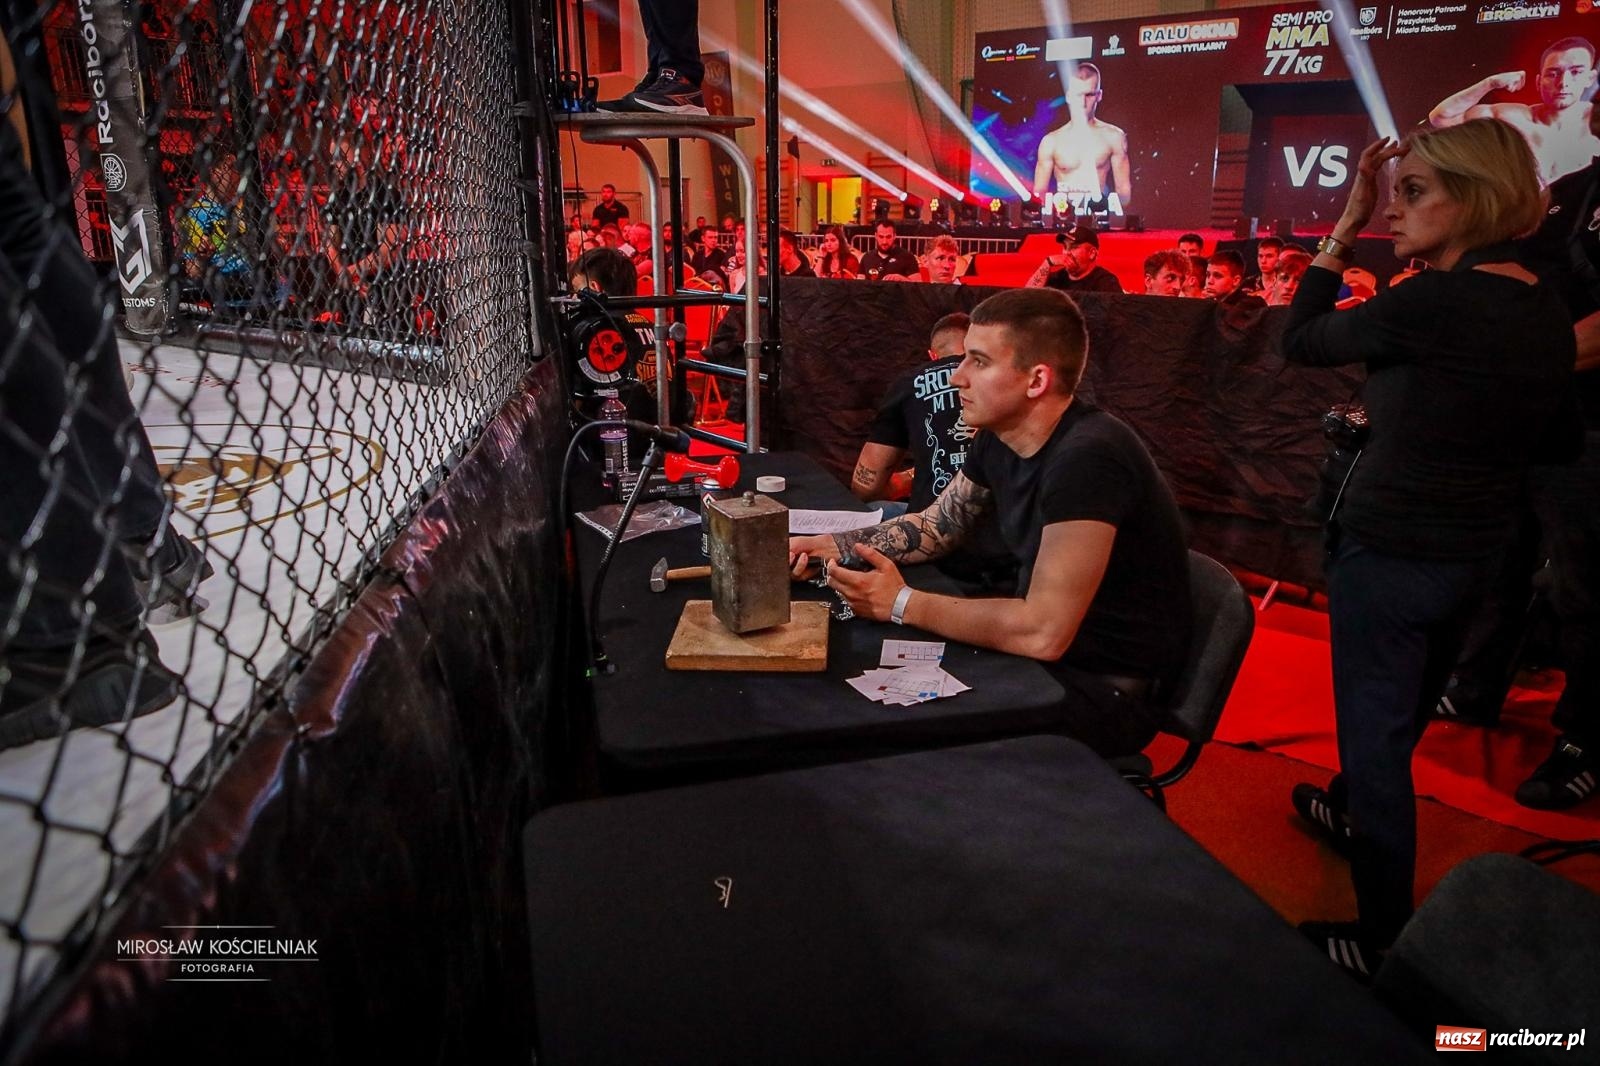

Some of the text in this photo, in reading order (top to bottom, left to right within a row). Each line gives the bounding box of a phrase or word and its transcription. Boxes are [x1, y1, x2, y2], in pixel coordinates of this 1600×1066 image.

[1398, 4, 1467, 17] Honorowy Patronat
[1484, 4, 1560, 21] BROOKLYN
[1271, 9, 1334, 27] SEMI PRO
[1397, 16, 1437, 26] Prezydenta
[1142, 27, 1188, 42] RALU
[1395, 23, 1457, 34] Miasta Raciborza
[1265, 23, 1330, 50] MMA
[1147, 44, 1183, 55] SPONSOR
[1282, 145, 1349, 188] VS
[121, 297, 157, 308] USTOMS
